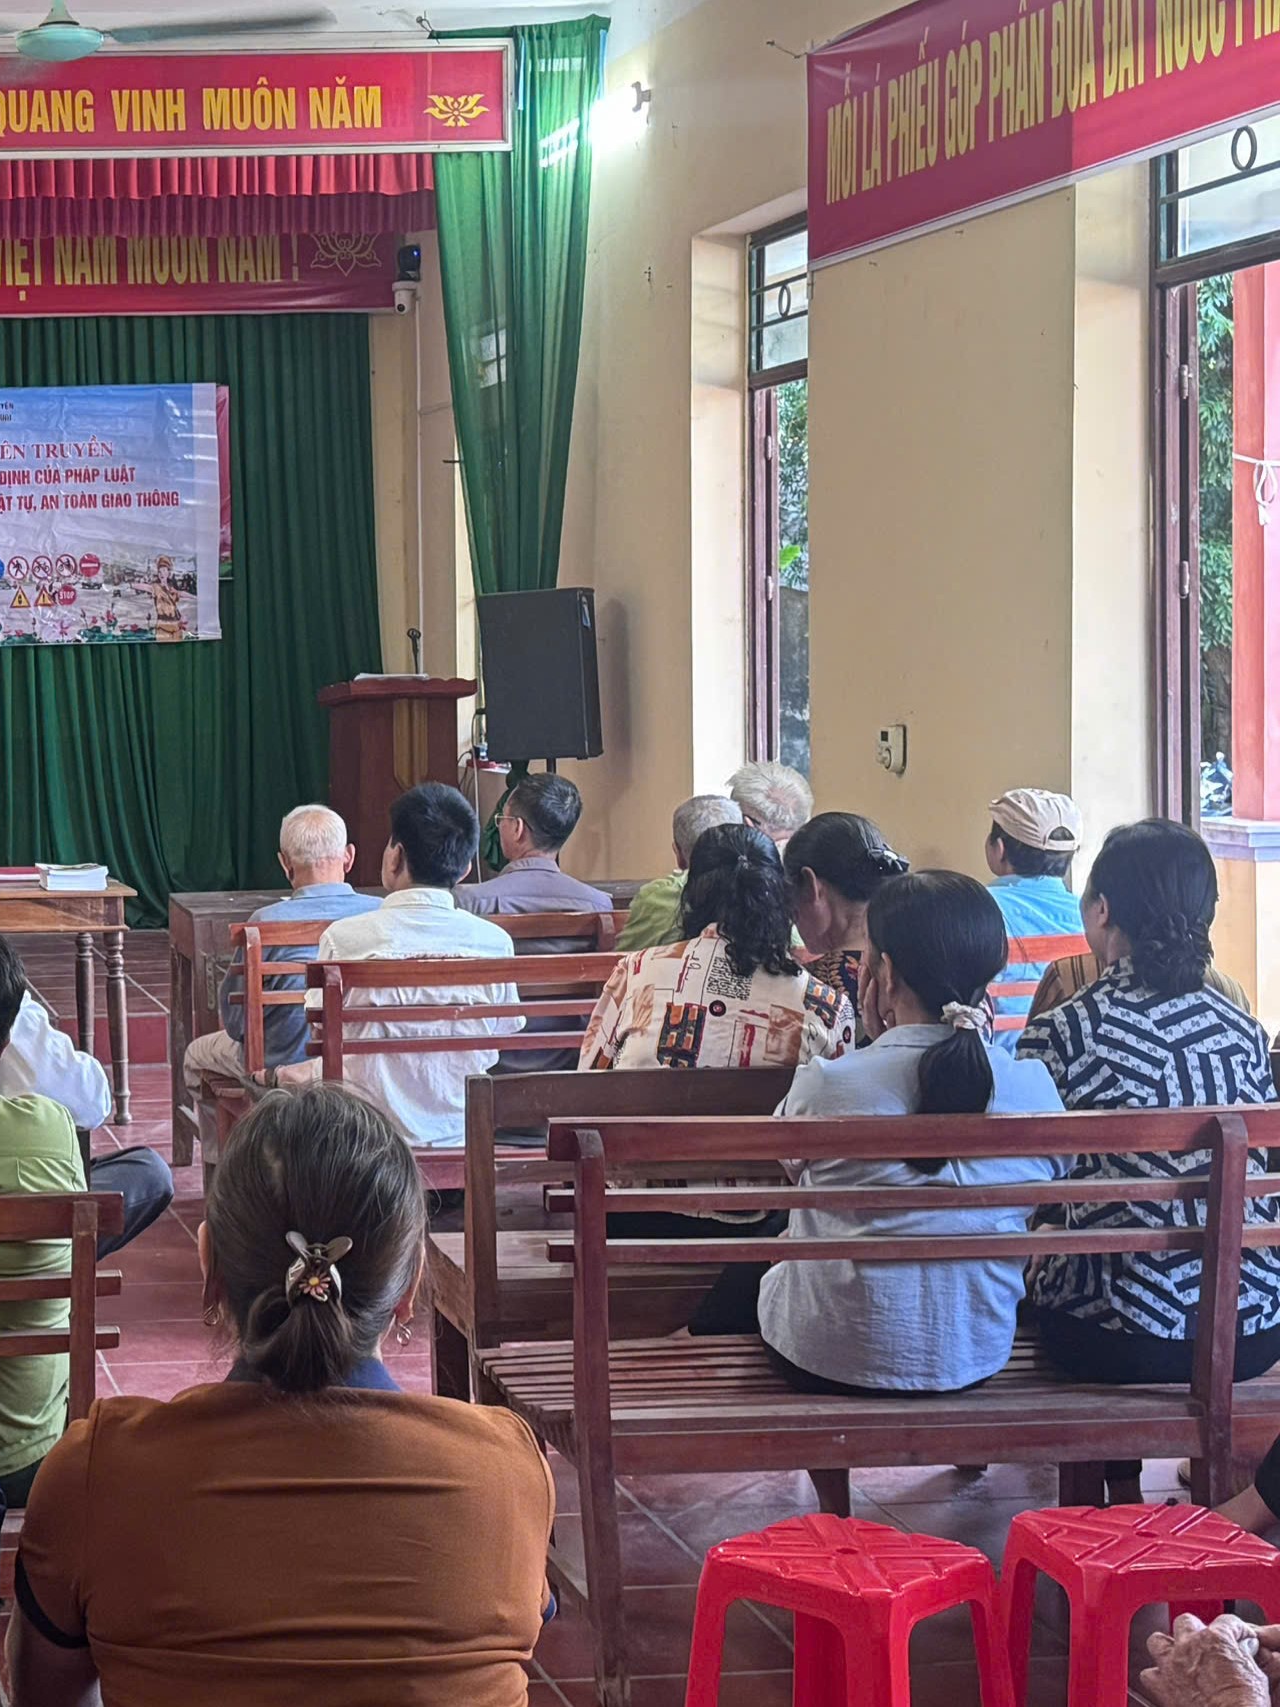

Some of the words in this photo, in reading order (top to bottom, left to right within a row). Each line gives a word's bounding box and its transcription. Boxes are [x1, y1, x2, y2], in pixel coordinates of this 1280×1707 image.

[111, 88, 187, 133] VINH
[202, 76, 297, 131] MUÔN
[308, 75, 383, 130] NĂM
[861, 62, 882, 192] LÁ
[886, 26, 940, 183] PHIẾU
[944, 20, 983, 161] GÓP
[53, 234, 118, 286] NAM
[31, 434, 113, 459] TRUYỀN
[34, 464, 61, 485] CỦA
[65, 465, 100, 484] PHÁP
[104, 464, 136, 486] LUẬT
[40, 494, 59, 510] AN
[62, 491, 97, 509] TOÀN
[101, 492, 132, 508] GIAO
[136, 489, 180, 507] THÔNG
[59, 591, 75, 600] STOP
